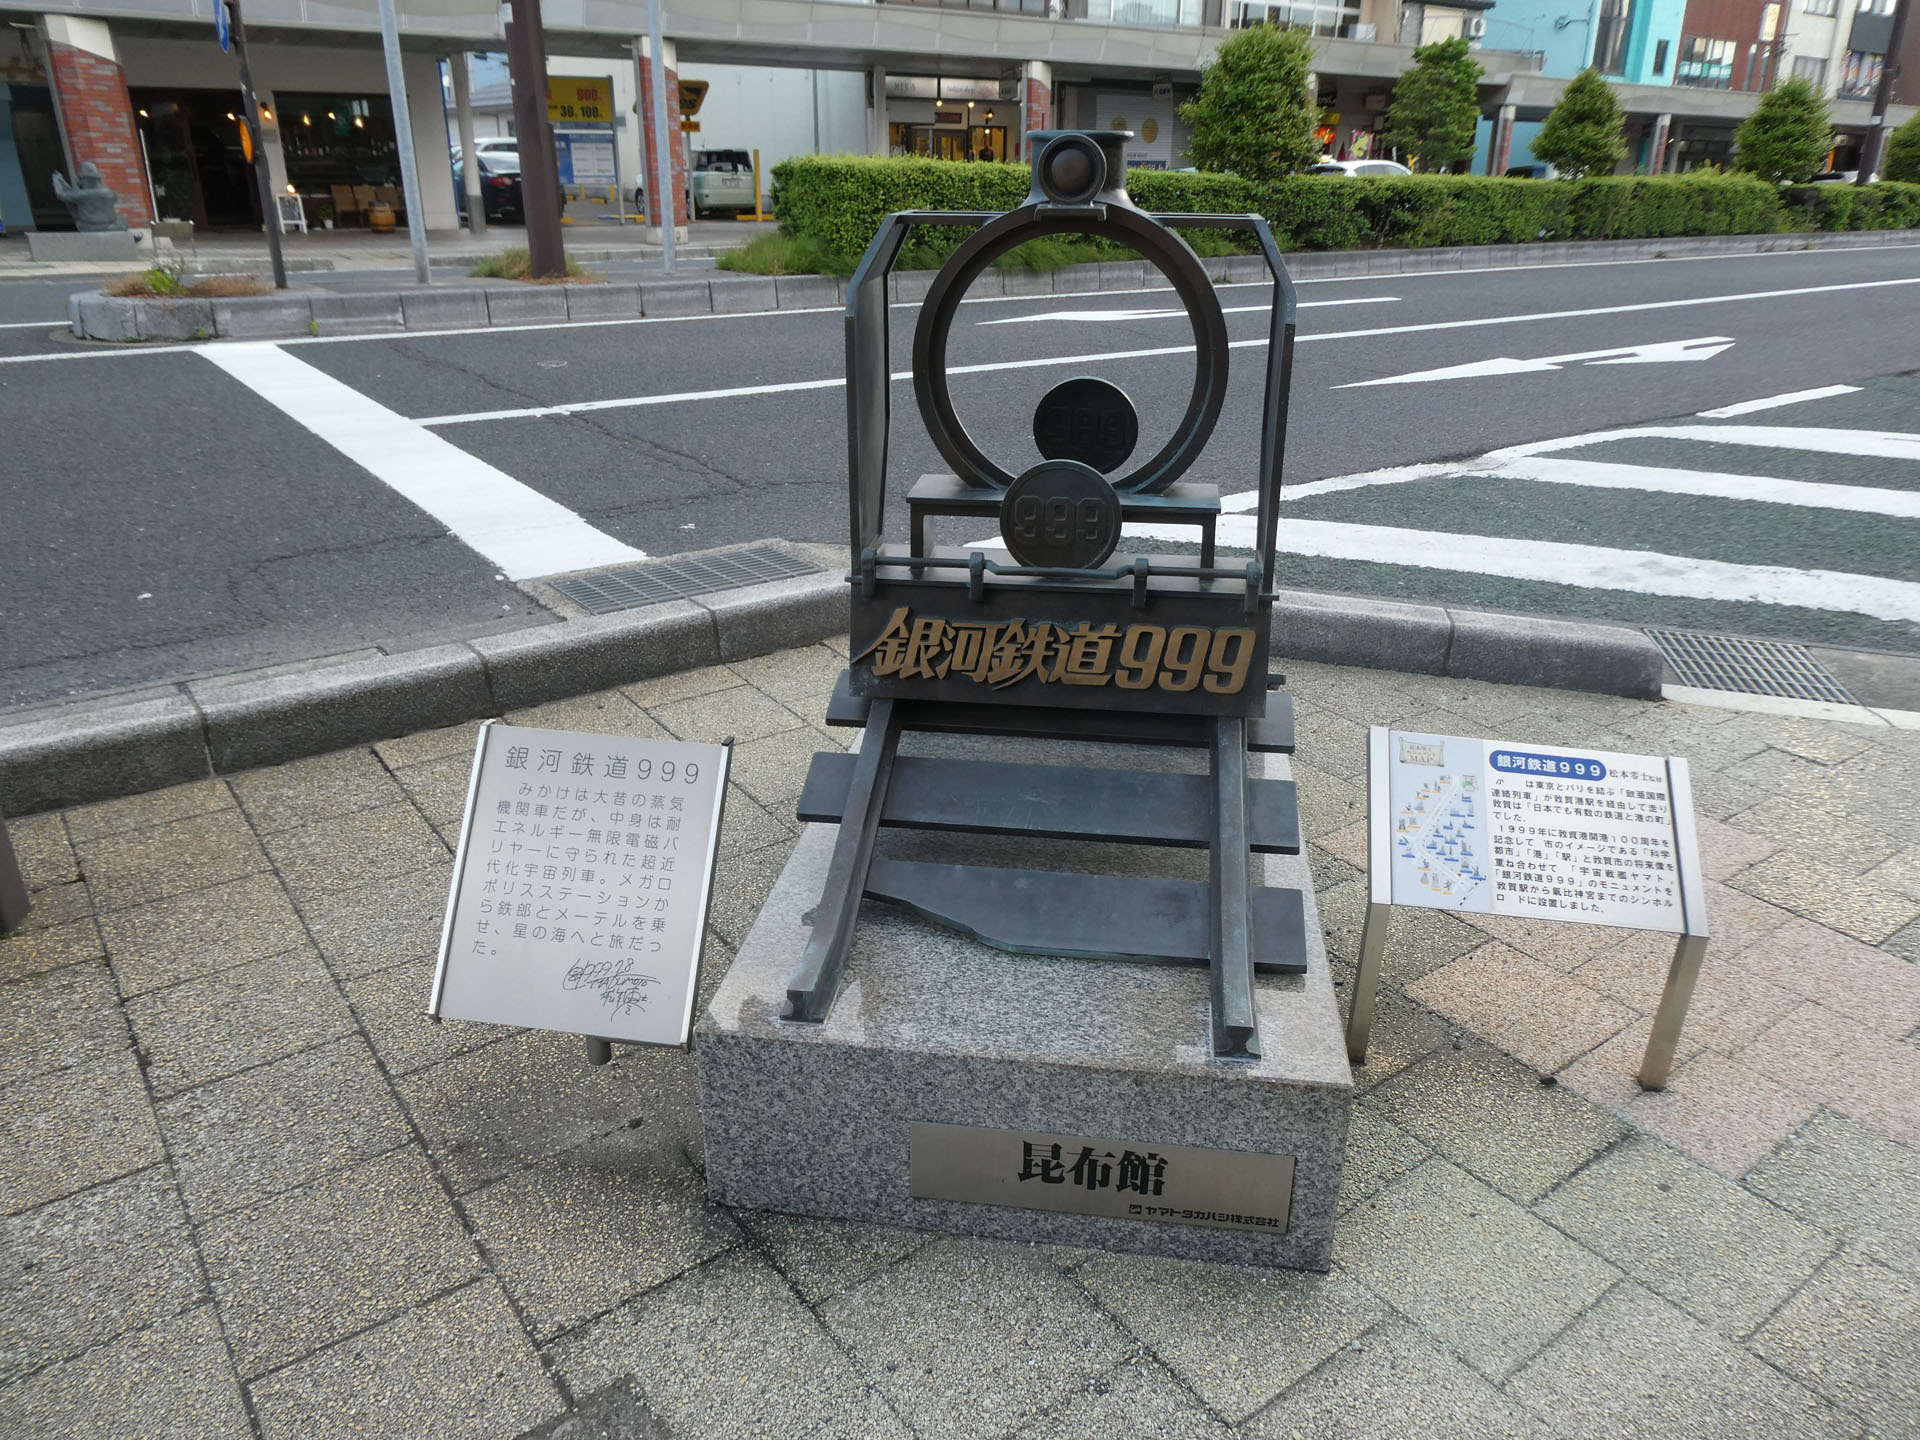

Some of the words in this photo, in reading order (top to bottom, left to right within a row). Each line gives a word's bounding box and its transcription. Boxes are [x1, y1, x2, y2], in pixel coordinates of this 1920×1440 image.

[1014, 495, 1107, 545] 999
[851, 608, 1257, 694] 銀河鉄道999
[504, 745, 700, 785] 銀河鉄道999
[1496, 754, 1601, 777] 銀河鉄道999
[518, 782, 685, 812] みかけは大昔の蒸気
[496, 800, 682, 832] 機関車だが、中身は耐
[492, 820, 679, 851] エネルギー無限電磁バ
[489, 839, 676, 872] リヤーに守られた超近
[485, 858, 672, 891] 代化宇宙列車。メガロ
[482, 879, 670, 912] ポリスステーションか
[479, 899, 667, 933] ら鉄郎とメーテルを乗
[471, 938, 498, 957] た。
[475, 919, 662, 953] せ、星の海へと旅だっ
[1017, 1140, 1169, 1196] 昆布館
[1145, 1206, 1280, 1228] ヤマトタカハシ株式会社
